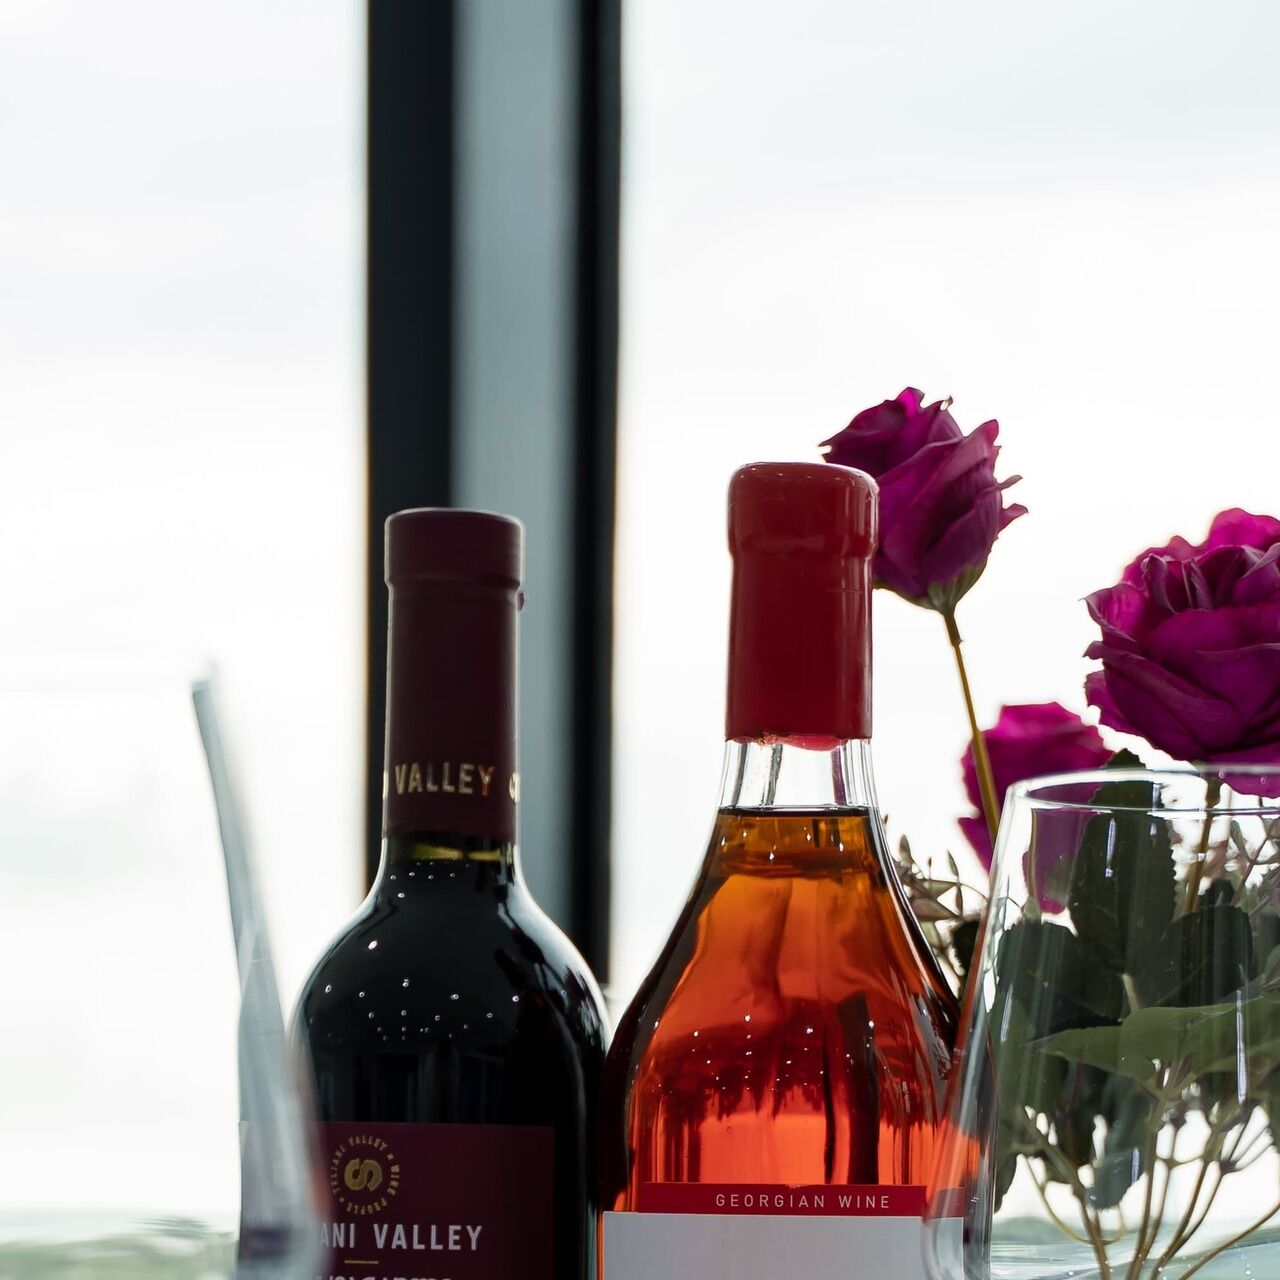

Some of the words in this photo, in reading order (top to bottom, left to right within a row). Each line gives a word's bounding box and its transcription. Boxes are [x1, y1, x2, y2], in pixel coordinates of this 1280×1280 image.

[395, 762, 496, 796] VALLEY
[348, 1135, 388, 1152] VALLEY
[387, 1165, 400, 1196] WINE
[346, 1198, 388, 1216] PEOPLE
[715, 1194, 825, 1208] GEORGIAN
[838, 1195, 890, 1209] WINE
[373, 1223, 482, 1251] VALLEY
